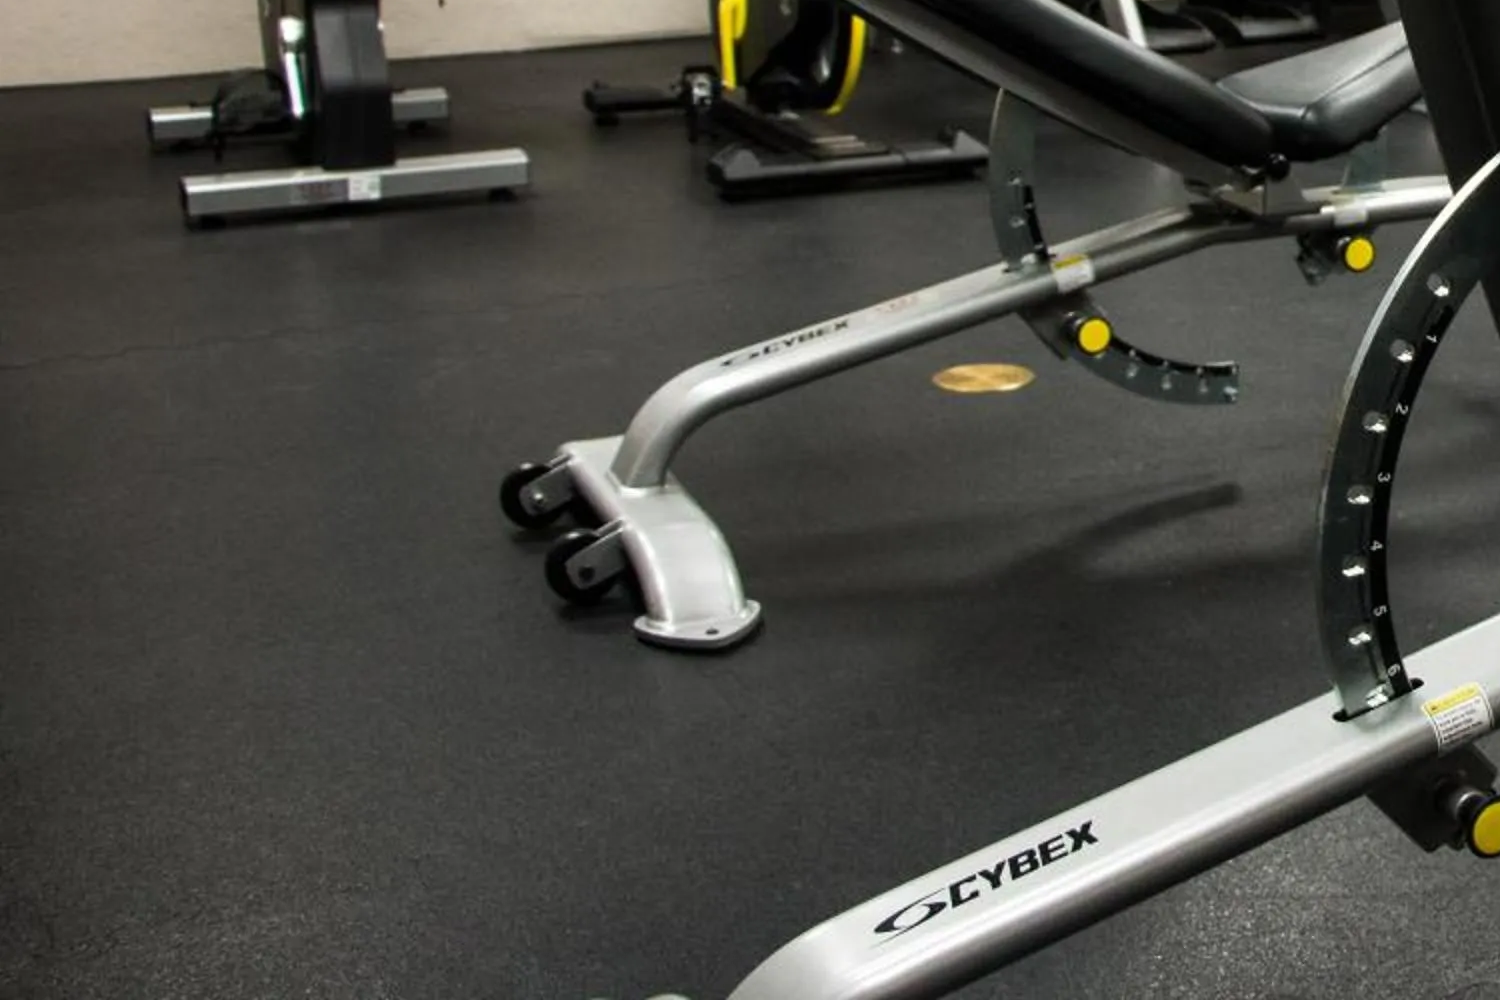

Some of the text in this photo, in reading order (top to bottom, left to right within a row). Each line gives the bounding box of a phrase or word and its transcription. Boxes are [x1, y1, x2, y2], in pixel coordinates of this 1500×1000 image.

[1395, 401, 1409, 415] 2
[1377, 471, 1391, 483] 3
[1370, 539, 1383, 551] 4
[1373, 604, 1388, 617] 5
[1387, 662, 1401, 677] 6
[949, 819, 1099, 909] CYBEX
